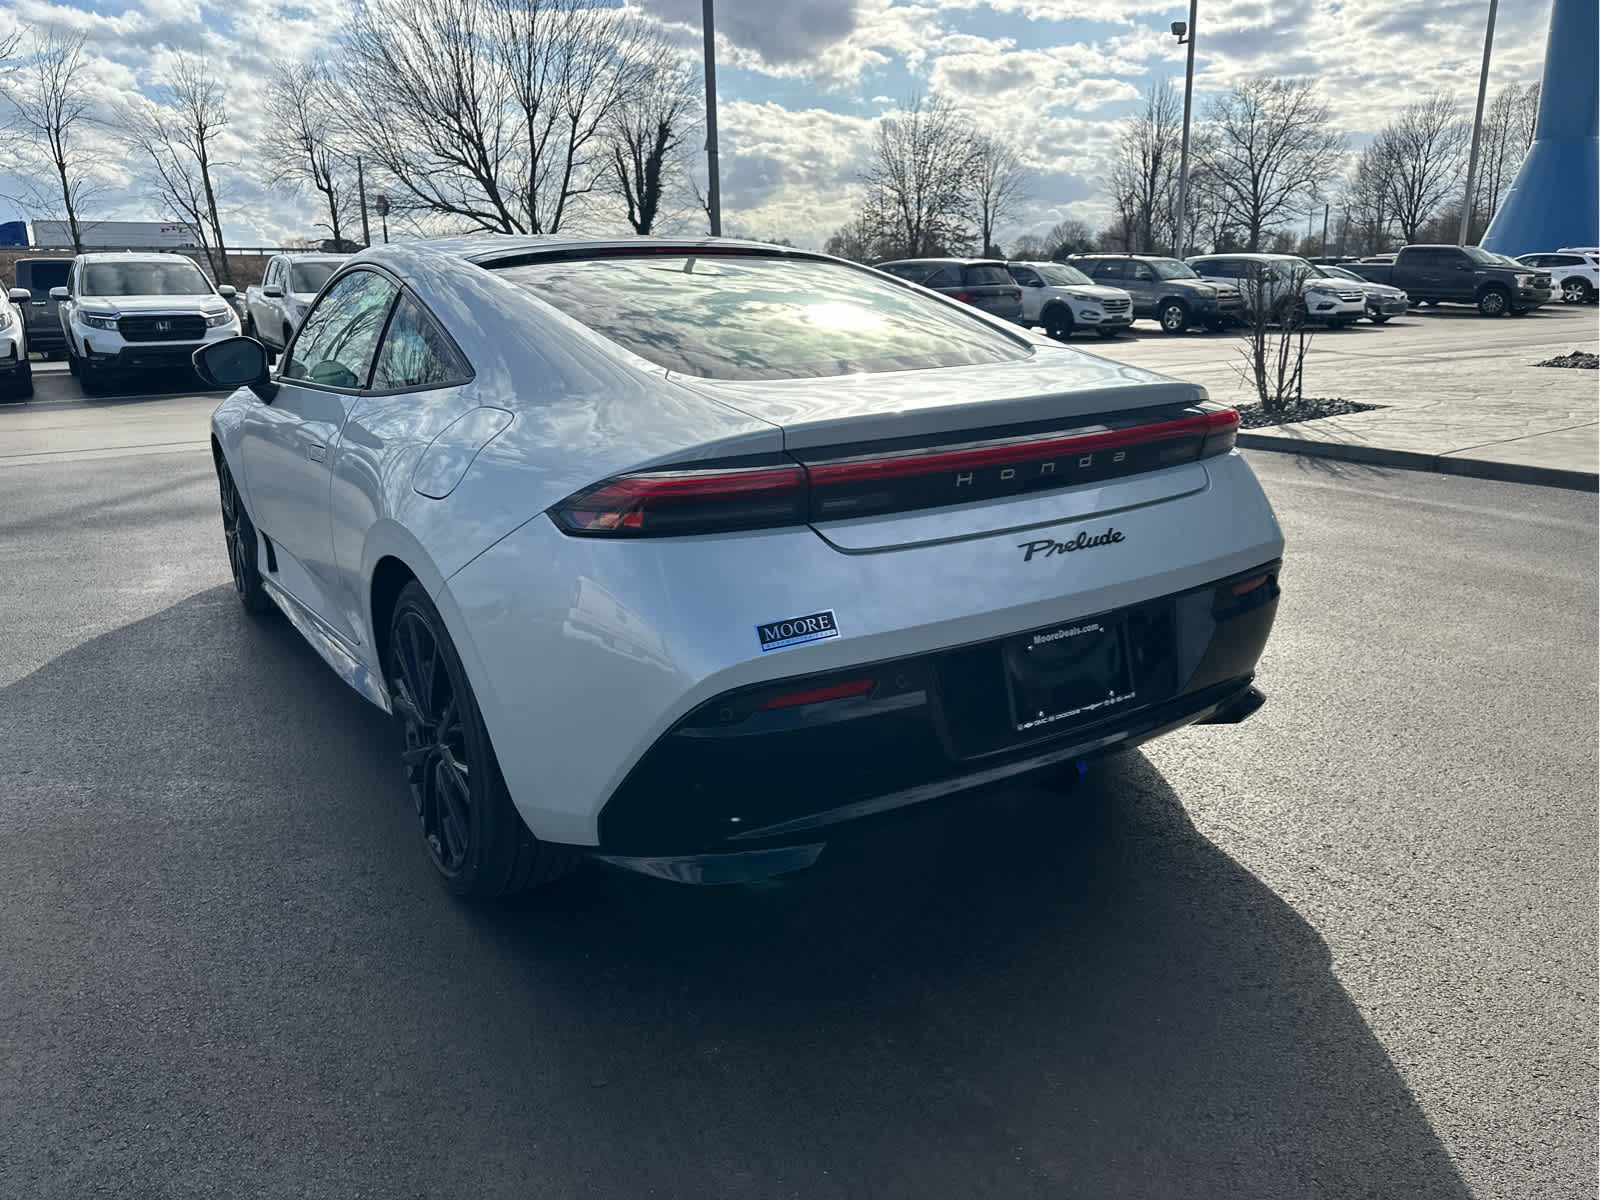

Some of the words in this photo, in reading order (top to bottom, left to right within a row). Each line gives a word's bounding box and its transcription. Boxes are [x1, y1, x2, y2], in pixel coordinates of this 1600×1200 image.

[956, 451, 1126, 487] Honda
[1017, 527, 1126, 562] Prelude
[764, 615, 832, 641] MOORE
[1033, 623, 1099, 645] MooreDeals.com
